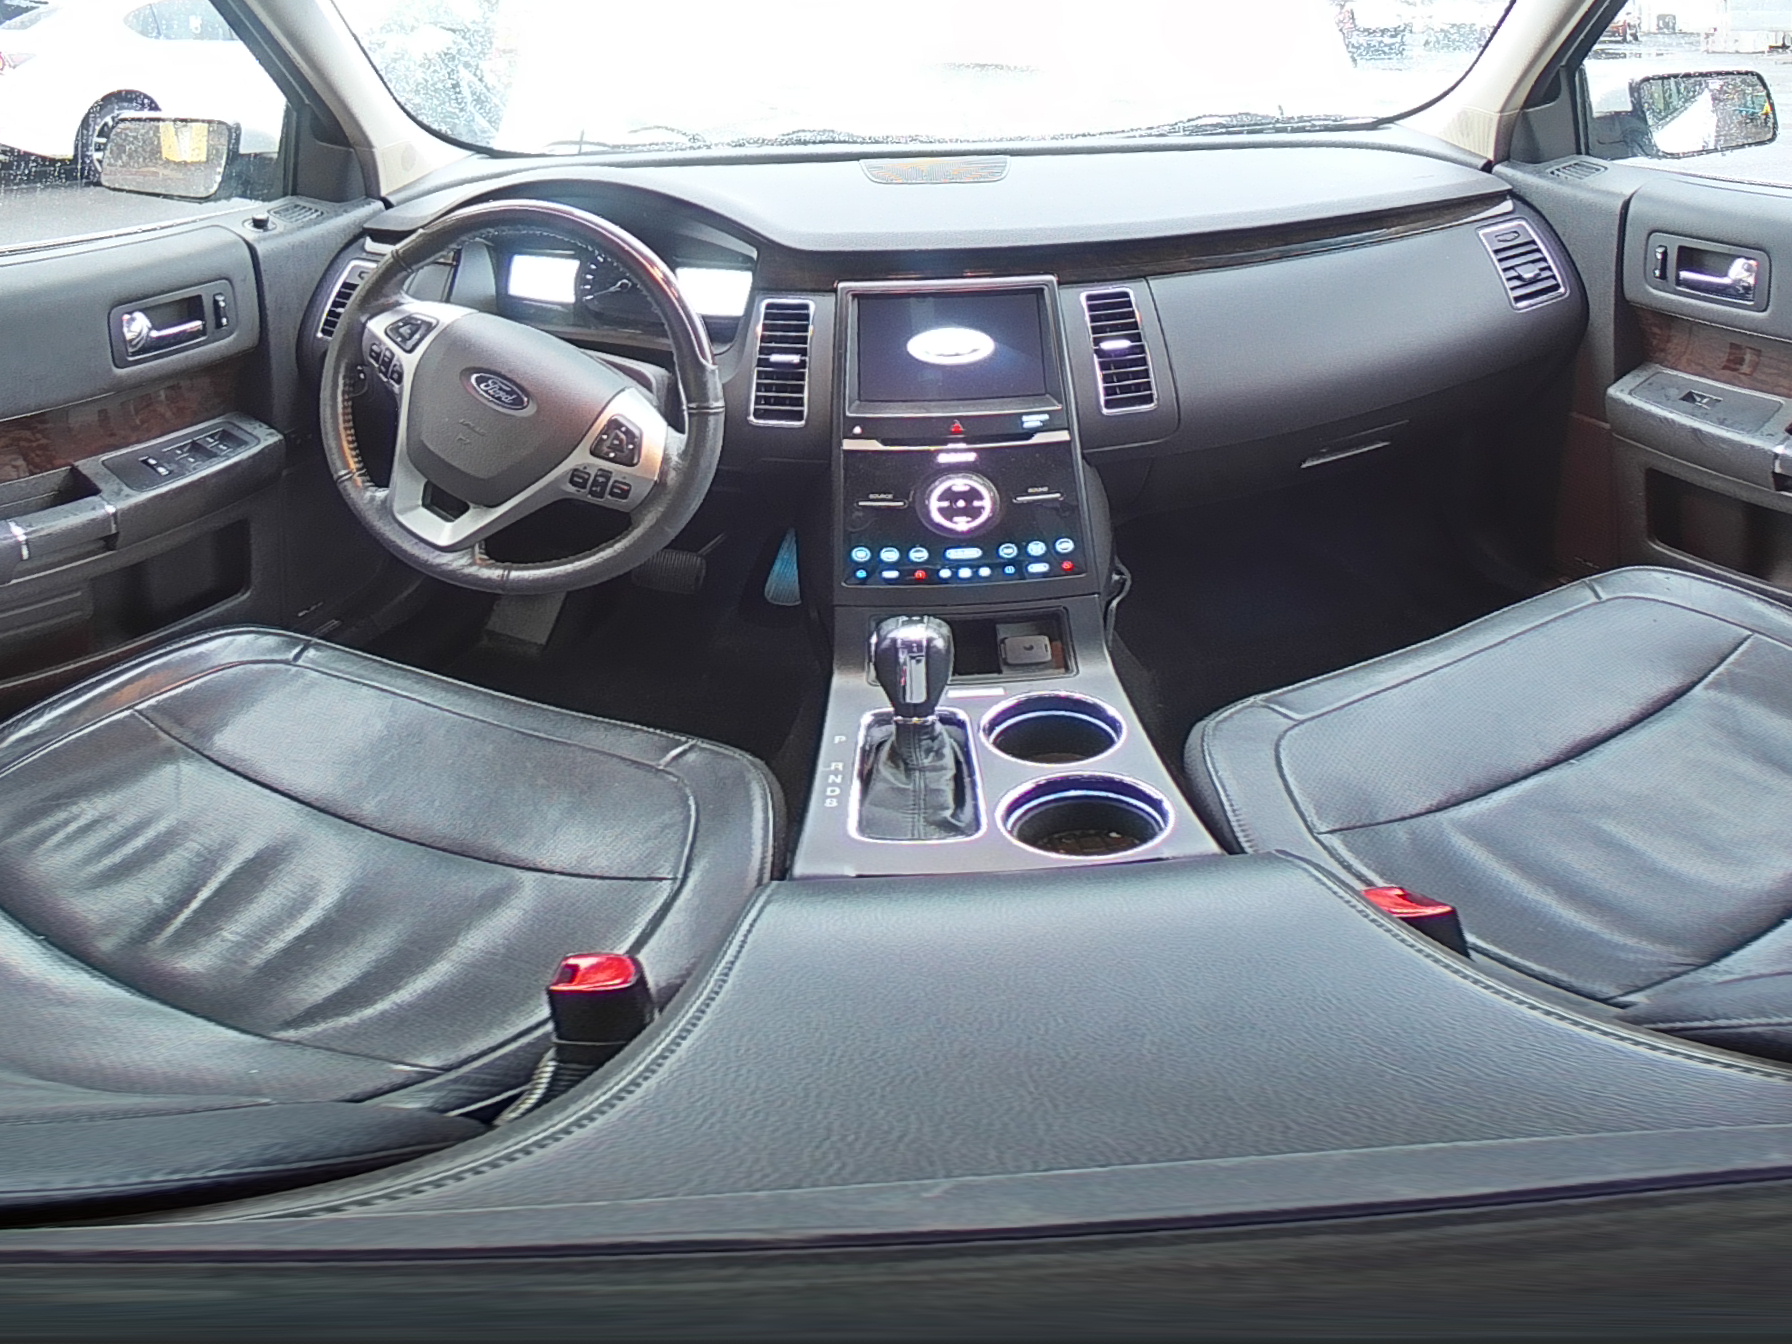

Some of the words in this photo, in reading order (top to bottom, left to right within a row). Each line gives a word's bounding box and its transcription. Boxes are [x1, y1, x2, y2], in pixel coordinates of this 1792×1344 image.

[478, 378, 518, 404] Ford
[833, 735, 847, 744] P
[827, 774, 843, 784] N
[825, 787, 841, 796] D
